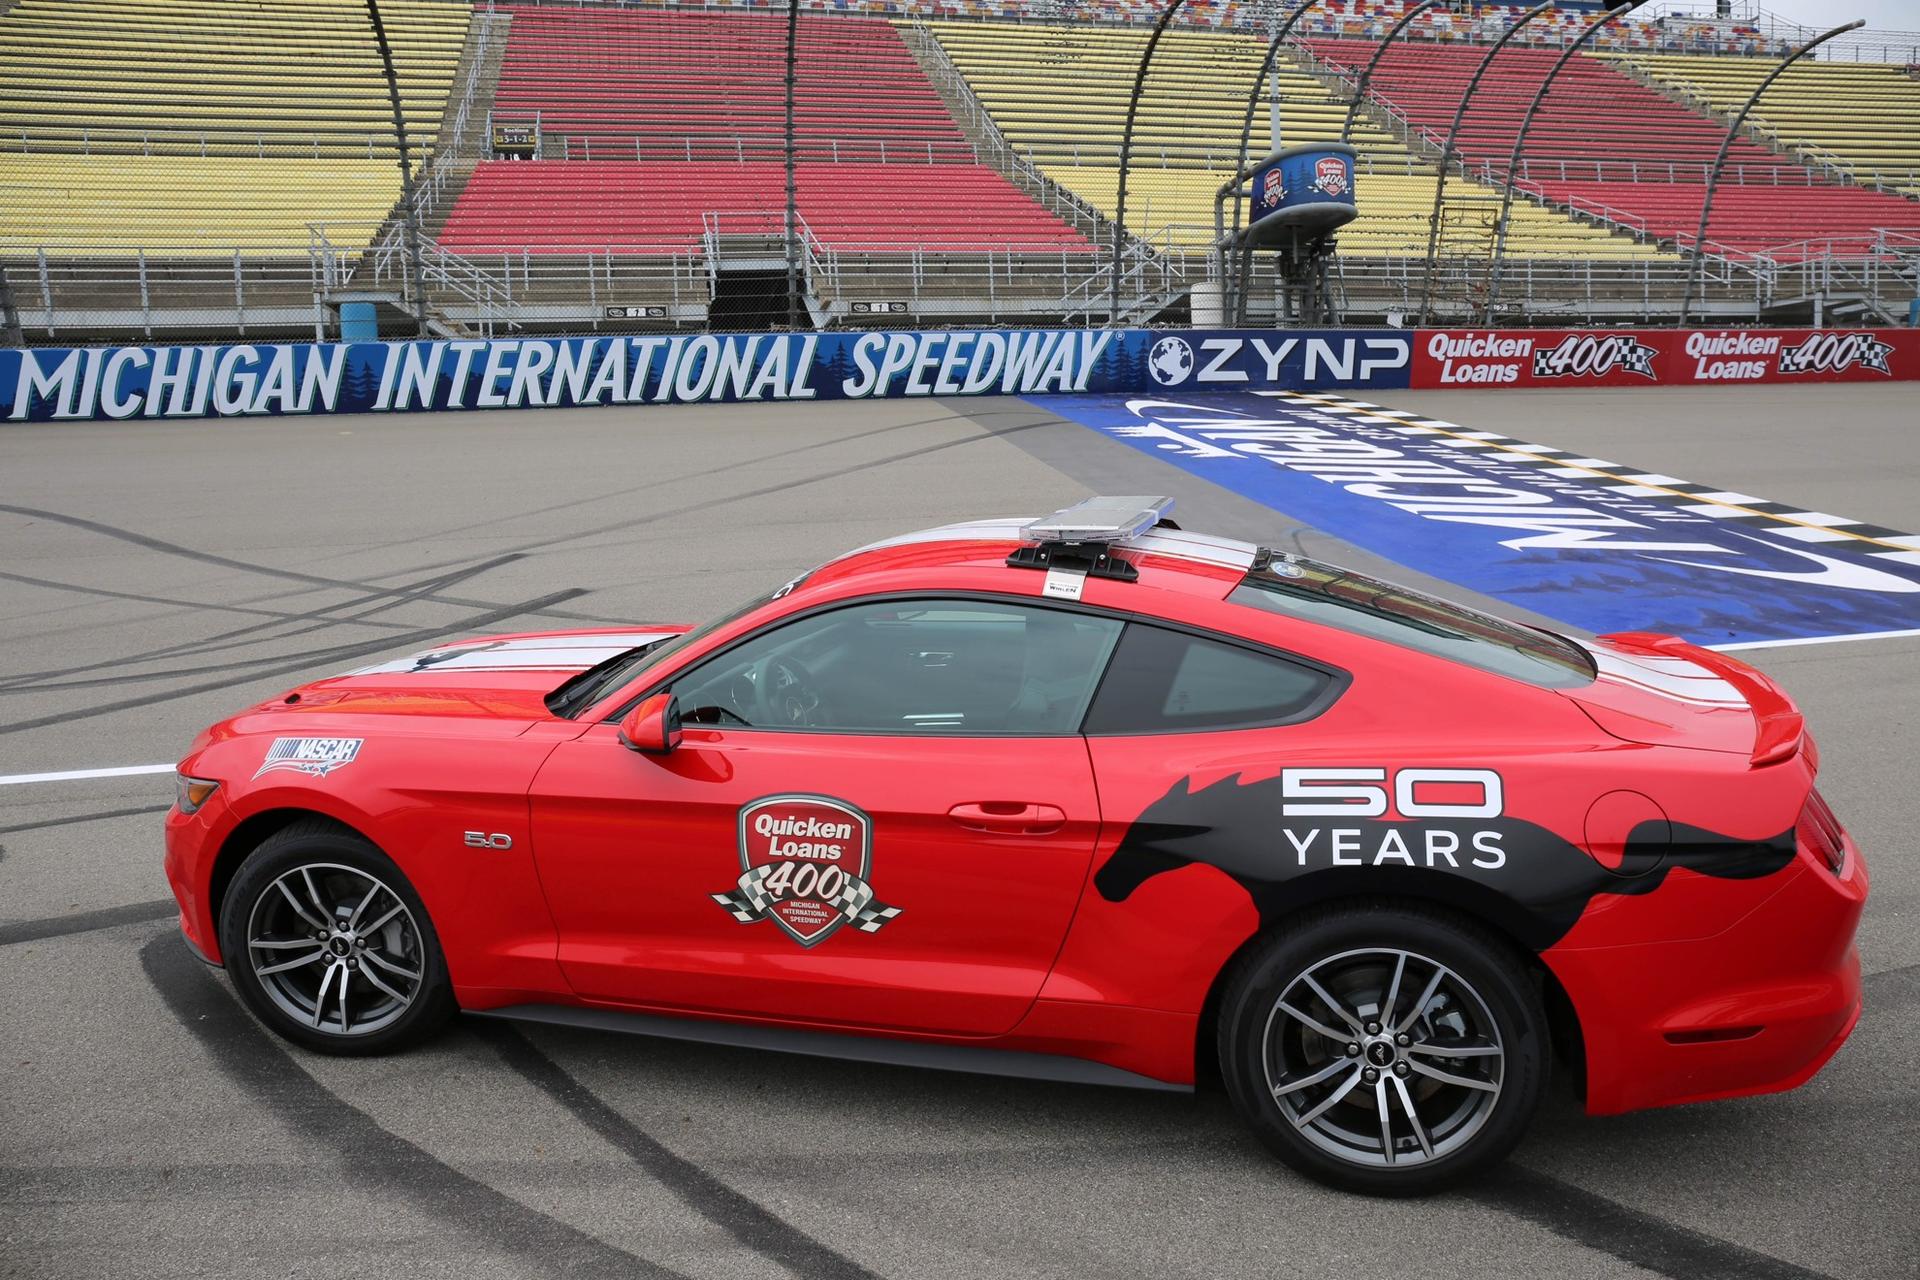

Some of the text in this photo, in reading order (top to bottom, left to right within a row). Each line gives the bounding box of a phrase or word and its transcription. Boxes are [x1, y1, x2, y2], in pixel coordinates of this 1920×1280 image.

[1428, 333, 1532, 361] Quicken
[1548, 336, 1619, 374] 400
[1685, 332, 1780, 359] Quicken
[1793, 334, 1858, 370] 400
[1197, 338, 1410, 382] ZYNP
[1440, 359, 1519, 383] Loans
[1694, 356, 1766, 379] Loans
[8, 344, 350, 420] MICHIGAN
[370, 334, 819, 409] INTERNATIONAL
[1152, 416, 1745, 555] MICHIGAN
[293, 739, 357, 760] NASCAR
[1282, 767, 1503, 819] 50
[755, 813, 851, 840] Quicken
[769, 836, 842, 860] Loans
[1282, 828, 1507, 869] YEARS
[765, 860, 843, 899] 400
[783, 908, 829, 918] INTERNATIONAL
[790, 901, 820, 910] MICHIGAN
